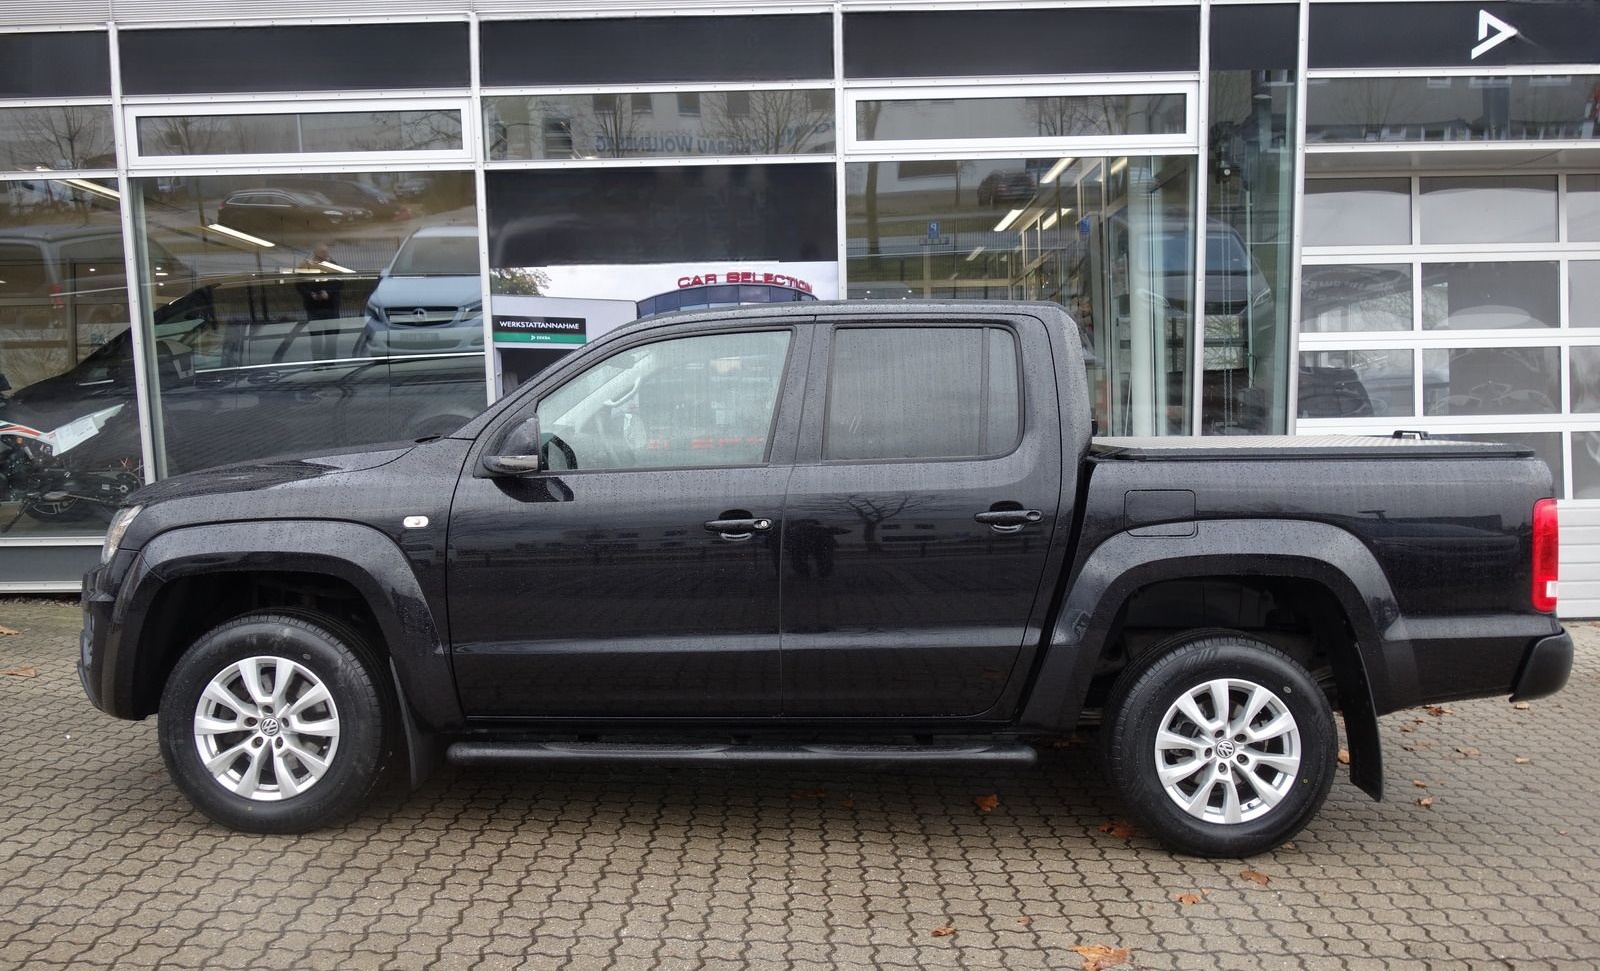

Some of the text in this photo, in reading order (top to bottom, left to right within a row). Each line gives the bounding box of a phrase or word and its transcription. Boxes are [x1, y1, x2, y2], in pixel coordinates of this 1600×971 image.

[677, 271, 813, 293] CAR SELECTION
[499, 320, 580, 330] WERKSTATTANNAHME
